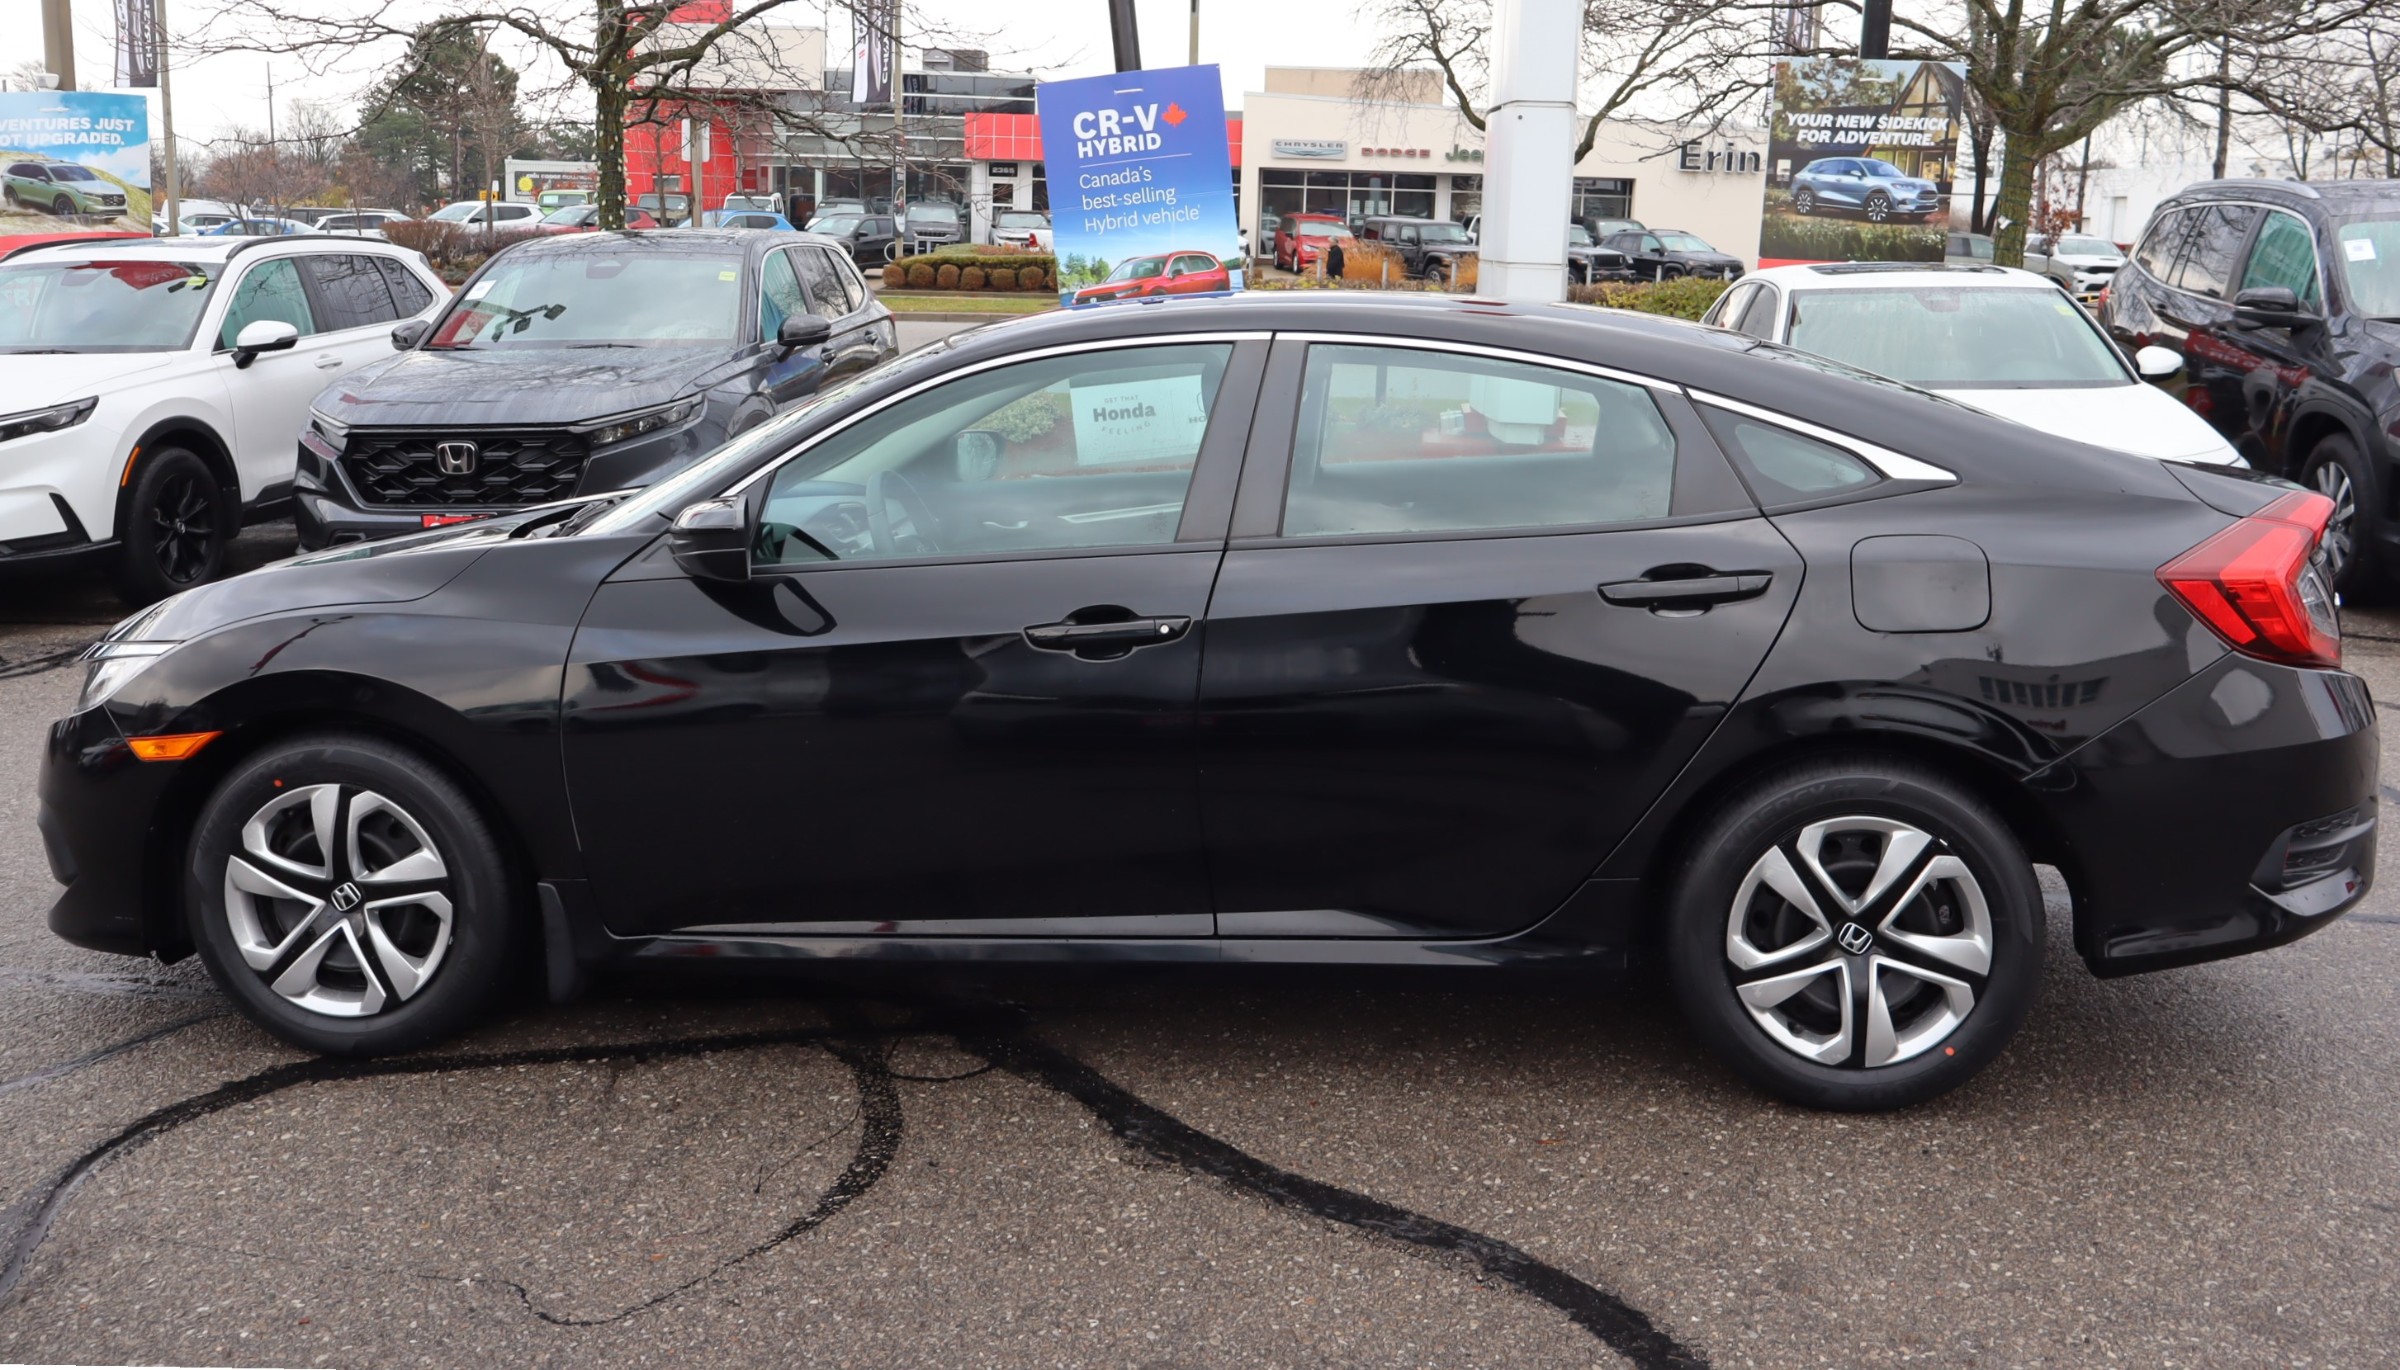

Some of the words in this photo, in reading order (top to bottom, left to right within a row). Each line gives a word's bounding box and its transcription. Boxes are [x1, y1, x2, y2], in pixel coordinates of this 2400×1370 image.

[94, 118, 135, 131] JUST
[1073, 103, 1158, 139] CR-V
[1786, 112, 1833, 128] YOUR
[1835, 114, 1875, 129] NEW
[1876, 115, 1949, 131] SIDEKICK
[26, 131, 126, 146] UPGRADED.
[1077, 133, 1162, 159] HYBRID
[1797, 129, 1831, 143] FOR
[1832, 131, 1936, 146] ADVENTURE.
[1361, 147, 1431, 158] DODGE
[1445, 143, 1485, 166] Jee
[1679, 140, 1761, 172] Erin
[1079, 166, 1152, 189] Canada's
[1082, 187, 1176, 211] best-selling
[1084, 211, 1139, 235] Hybrid
[1093, 402, 1157, 422] Honda
[1101, 422, 1151, 436] FEELING
